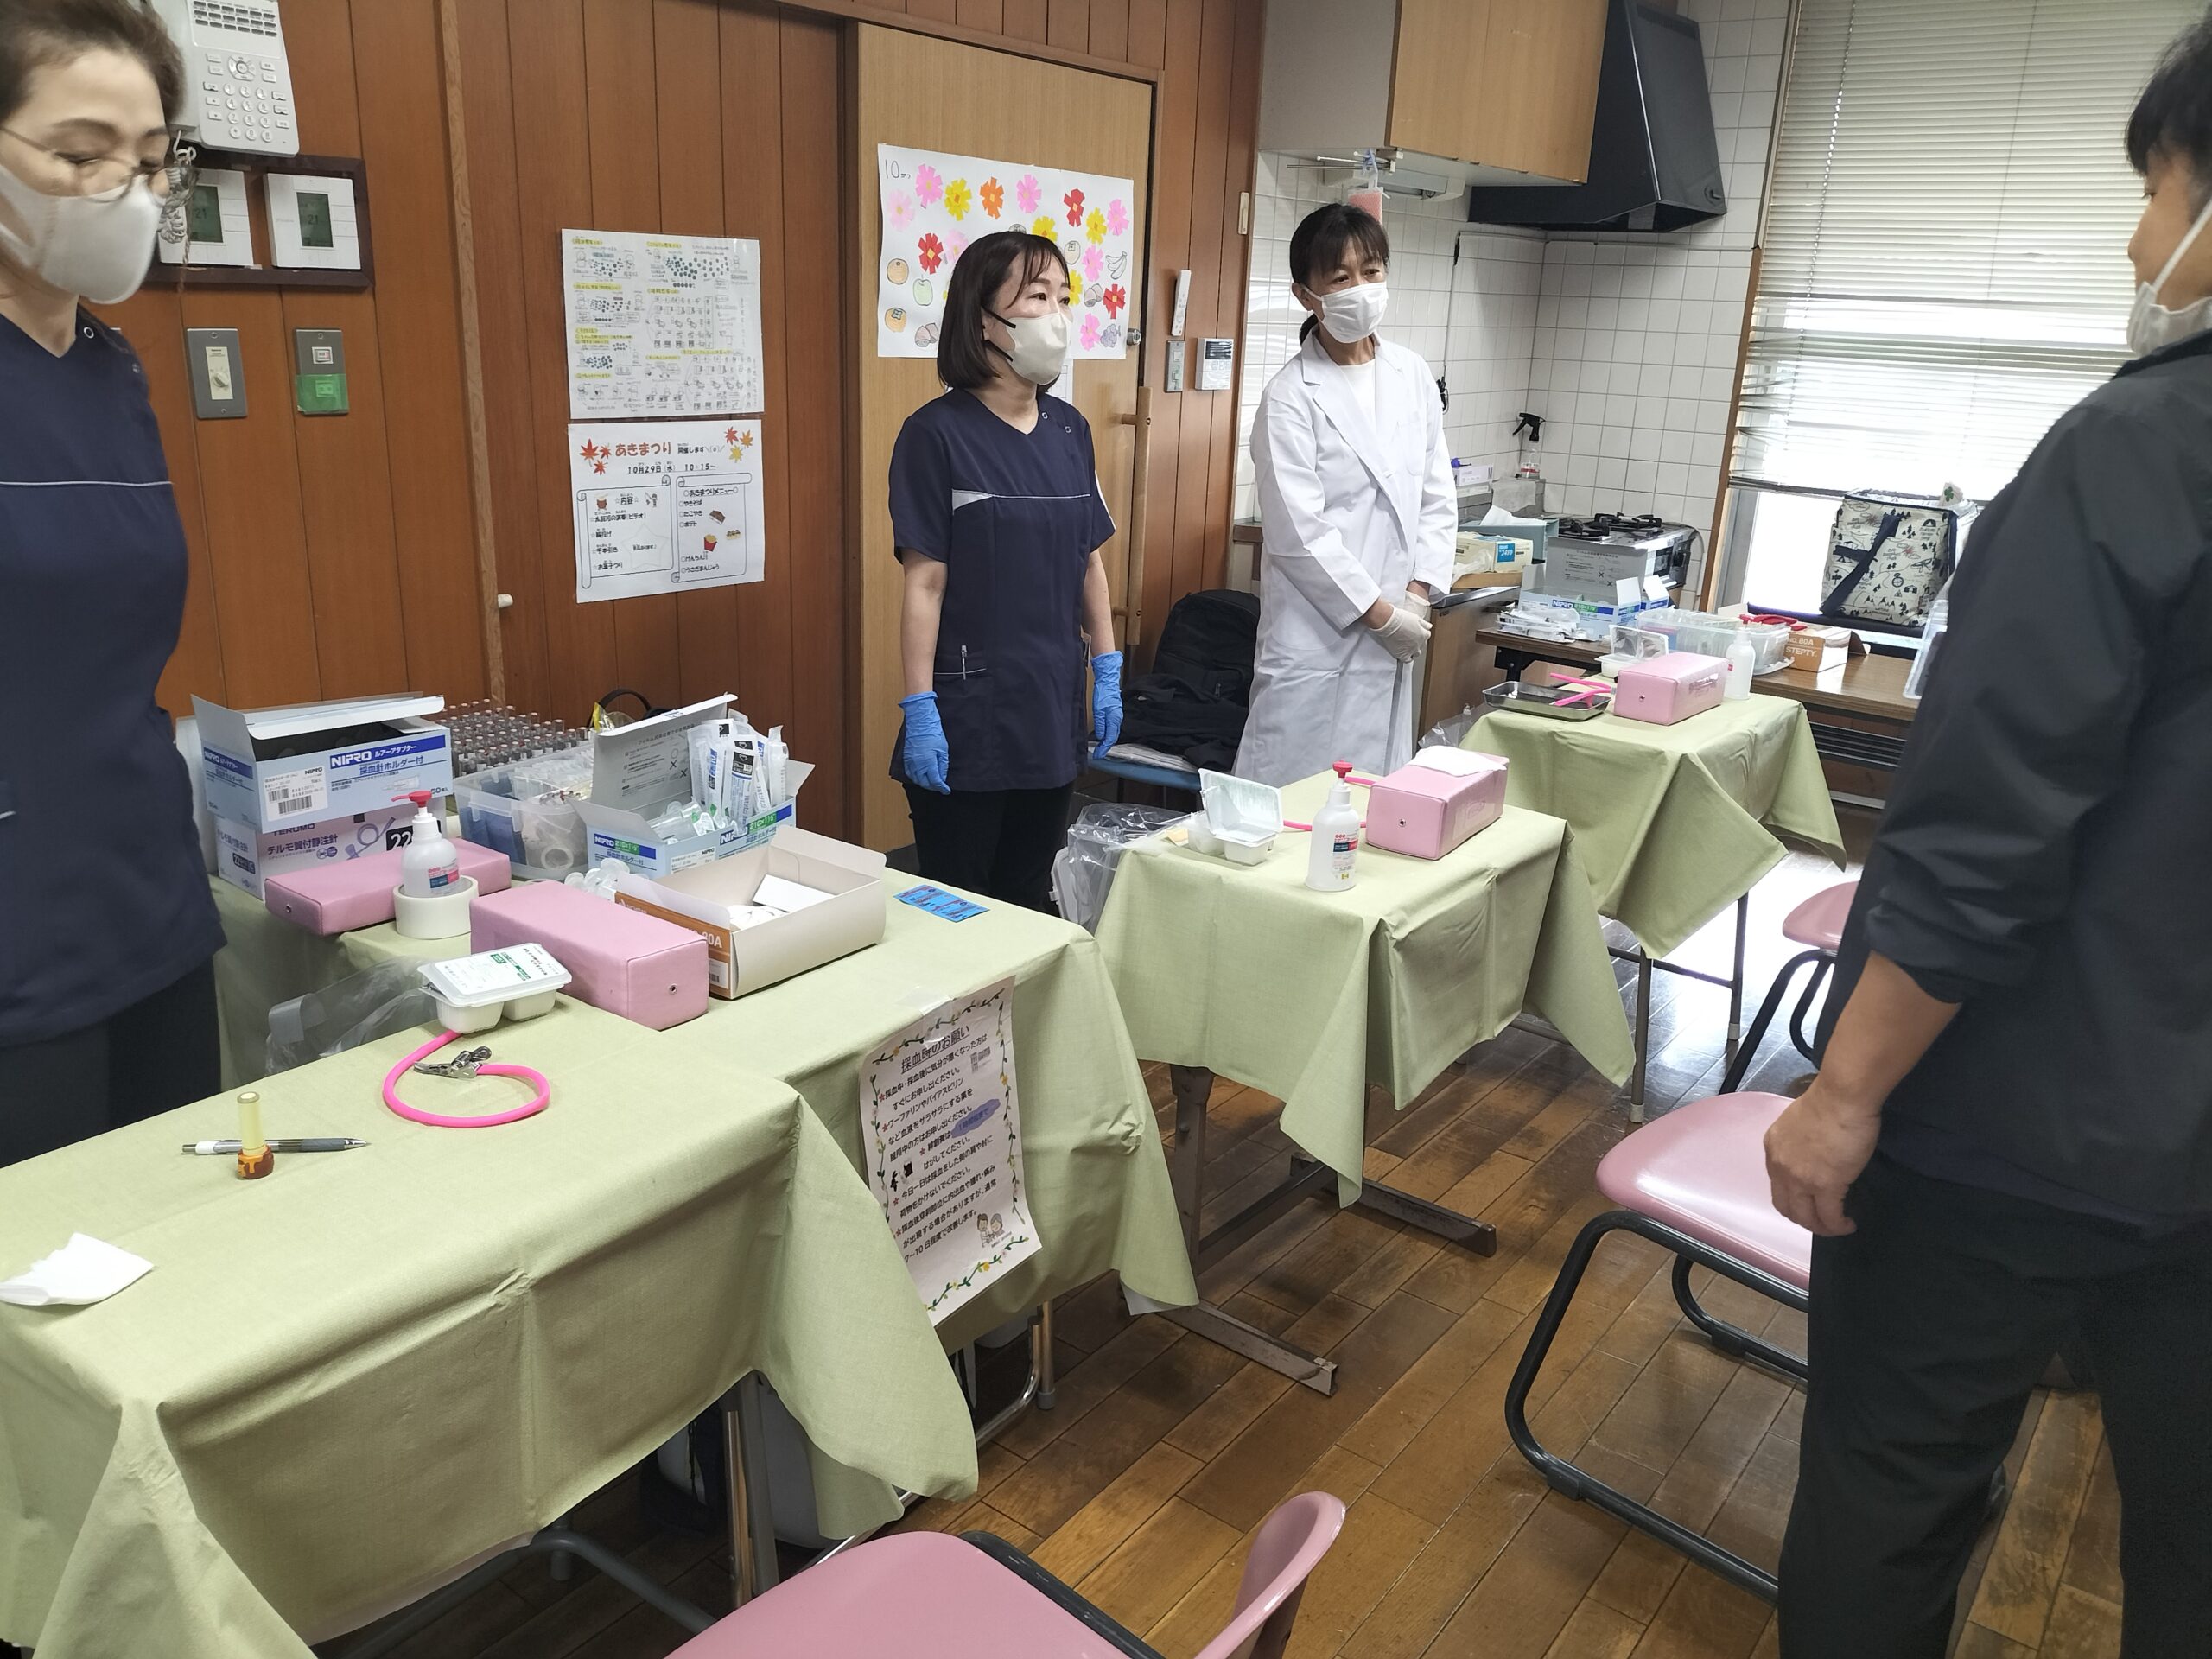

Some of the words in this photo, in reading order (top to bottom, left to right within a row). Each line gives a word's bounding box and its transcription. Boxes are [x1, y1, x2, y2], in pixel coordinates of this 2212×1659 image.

[615, 442, 671, 457] あきまつり
[1798, 637, 1814, 646] 80A
[1785, 645, 1817, 658] STEPTY
[331, 751, 372, 766] NIPRO
[375, 745, 416, 758] ルアーアダプター
[304, 766, 323, 775] NIPRO
[359, 756, 423, 776] 採血針ホルダー付
[267, 834, 338, 855] テルモ翼付静注針
[594, 836, 614, 848] NIPRO
[901, 1026, 970, 1072] 採血時のお願い
